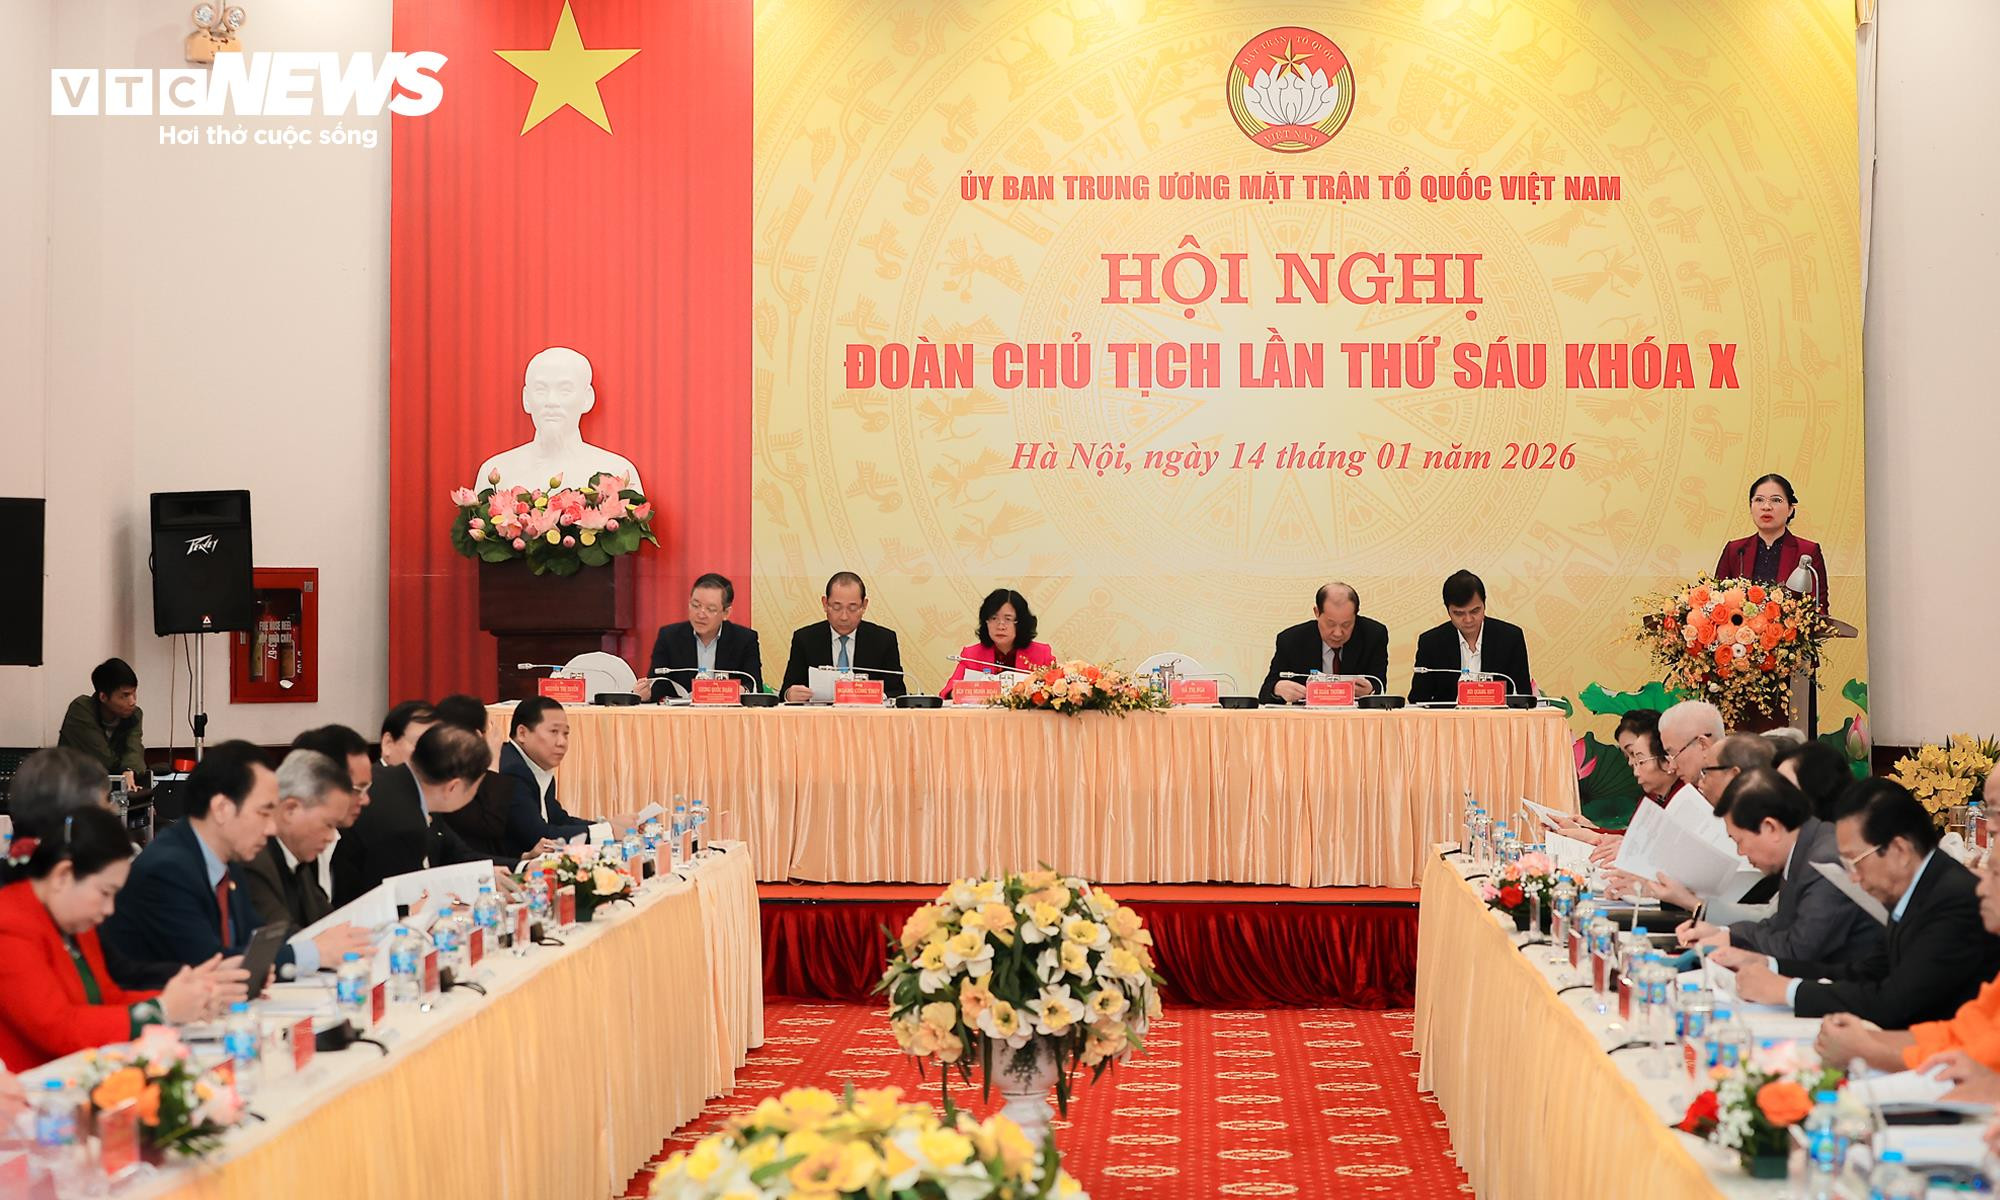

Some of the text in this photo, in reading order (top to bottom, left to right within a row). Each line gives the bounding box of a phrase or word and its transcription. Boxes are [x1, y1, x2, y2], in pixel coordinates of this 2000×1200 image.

[960, 166, 1621, 206] ỦY BAN TRUNG ƯƠNG MẶT TRẬN TỔ QUỐC VIỆT NAM
[1100, 234, 1484, 321] HỘI NGHỊ
[845, 327, 1741, 398] ĐOÀN CHỦ TỊCH LẦN THỨ SÁU KHÓA X
[1010, 441, 1577, 477] Hà Nội, ngày 14 tháng 01 năm 2026
